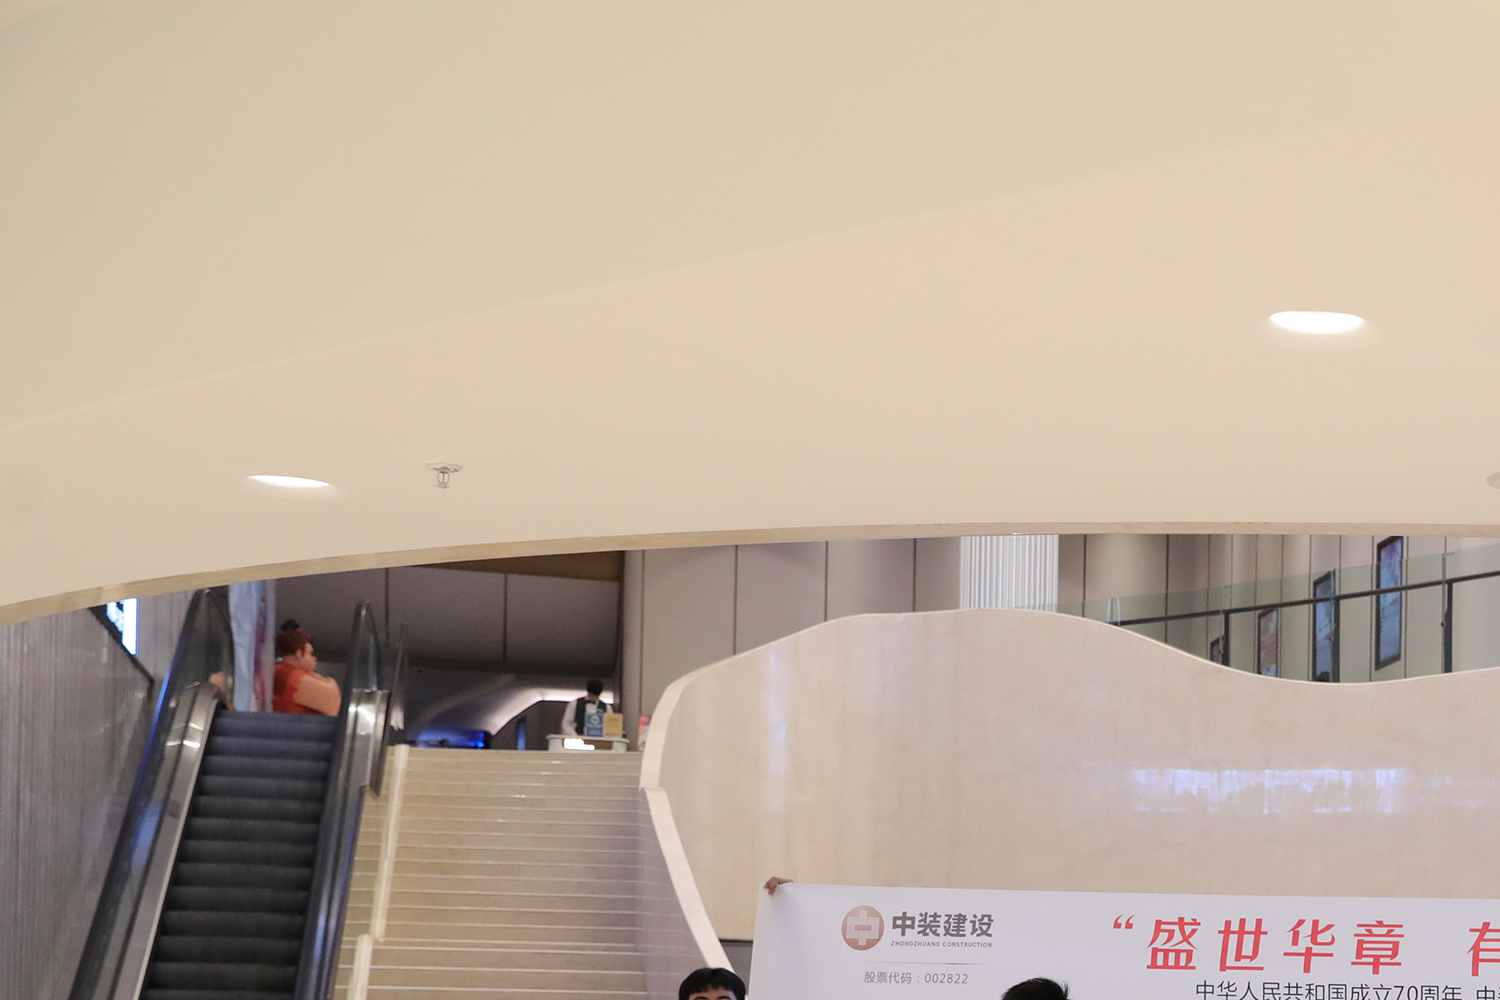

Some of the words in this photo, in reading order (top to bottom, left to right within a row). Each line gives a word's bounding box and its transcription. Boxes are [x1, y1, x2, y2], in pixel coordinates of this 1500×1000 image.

[891, 910, 995, 938] 中装建设
[890, 940, 940, 948] ZHONGZHUANG
[942, 941, 994, 949] CONSTRUCTION
[1112, 914, 1405, 976] “盛世华章
